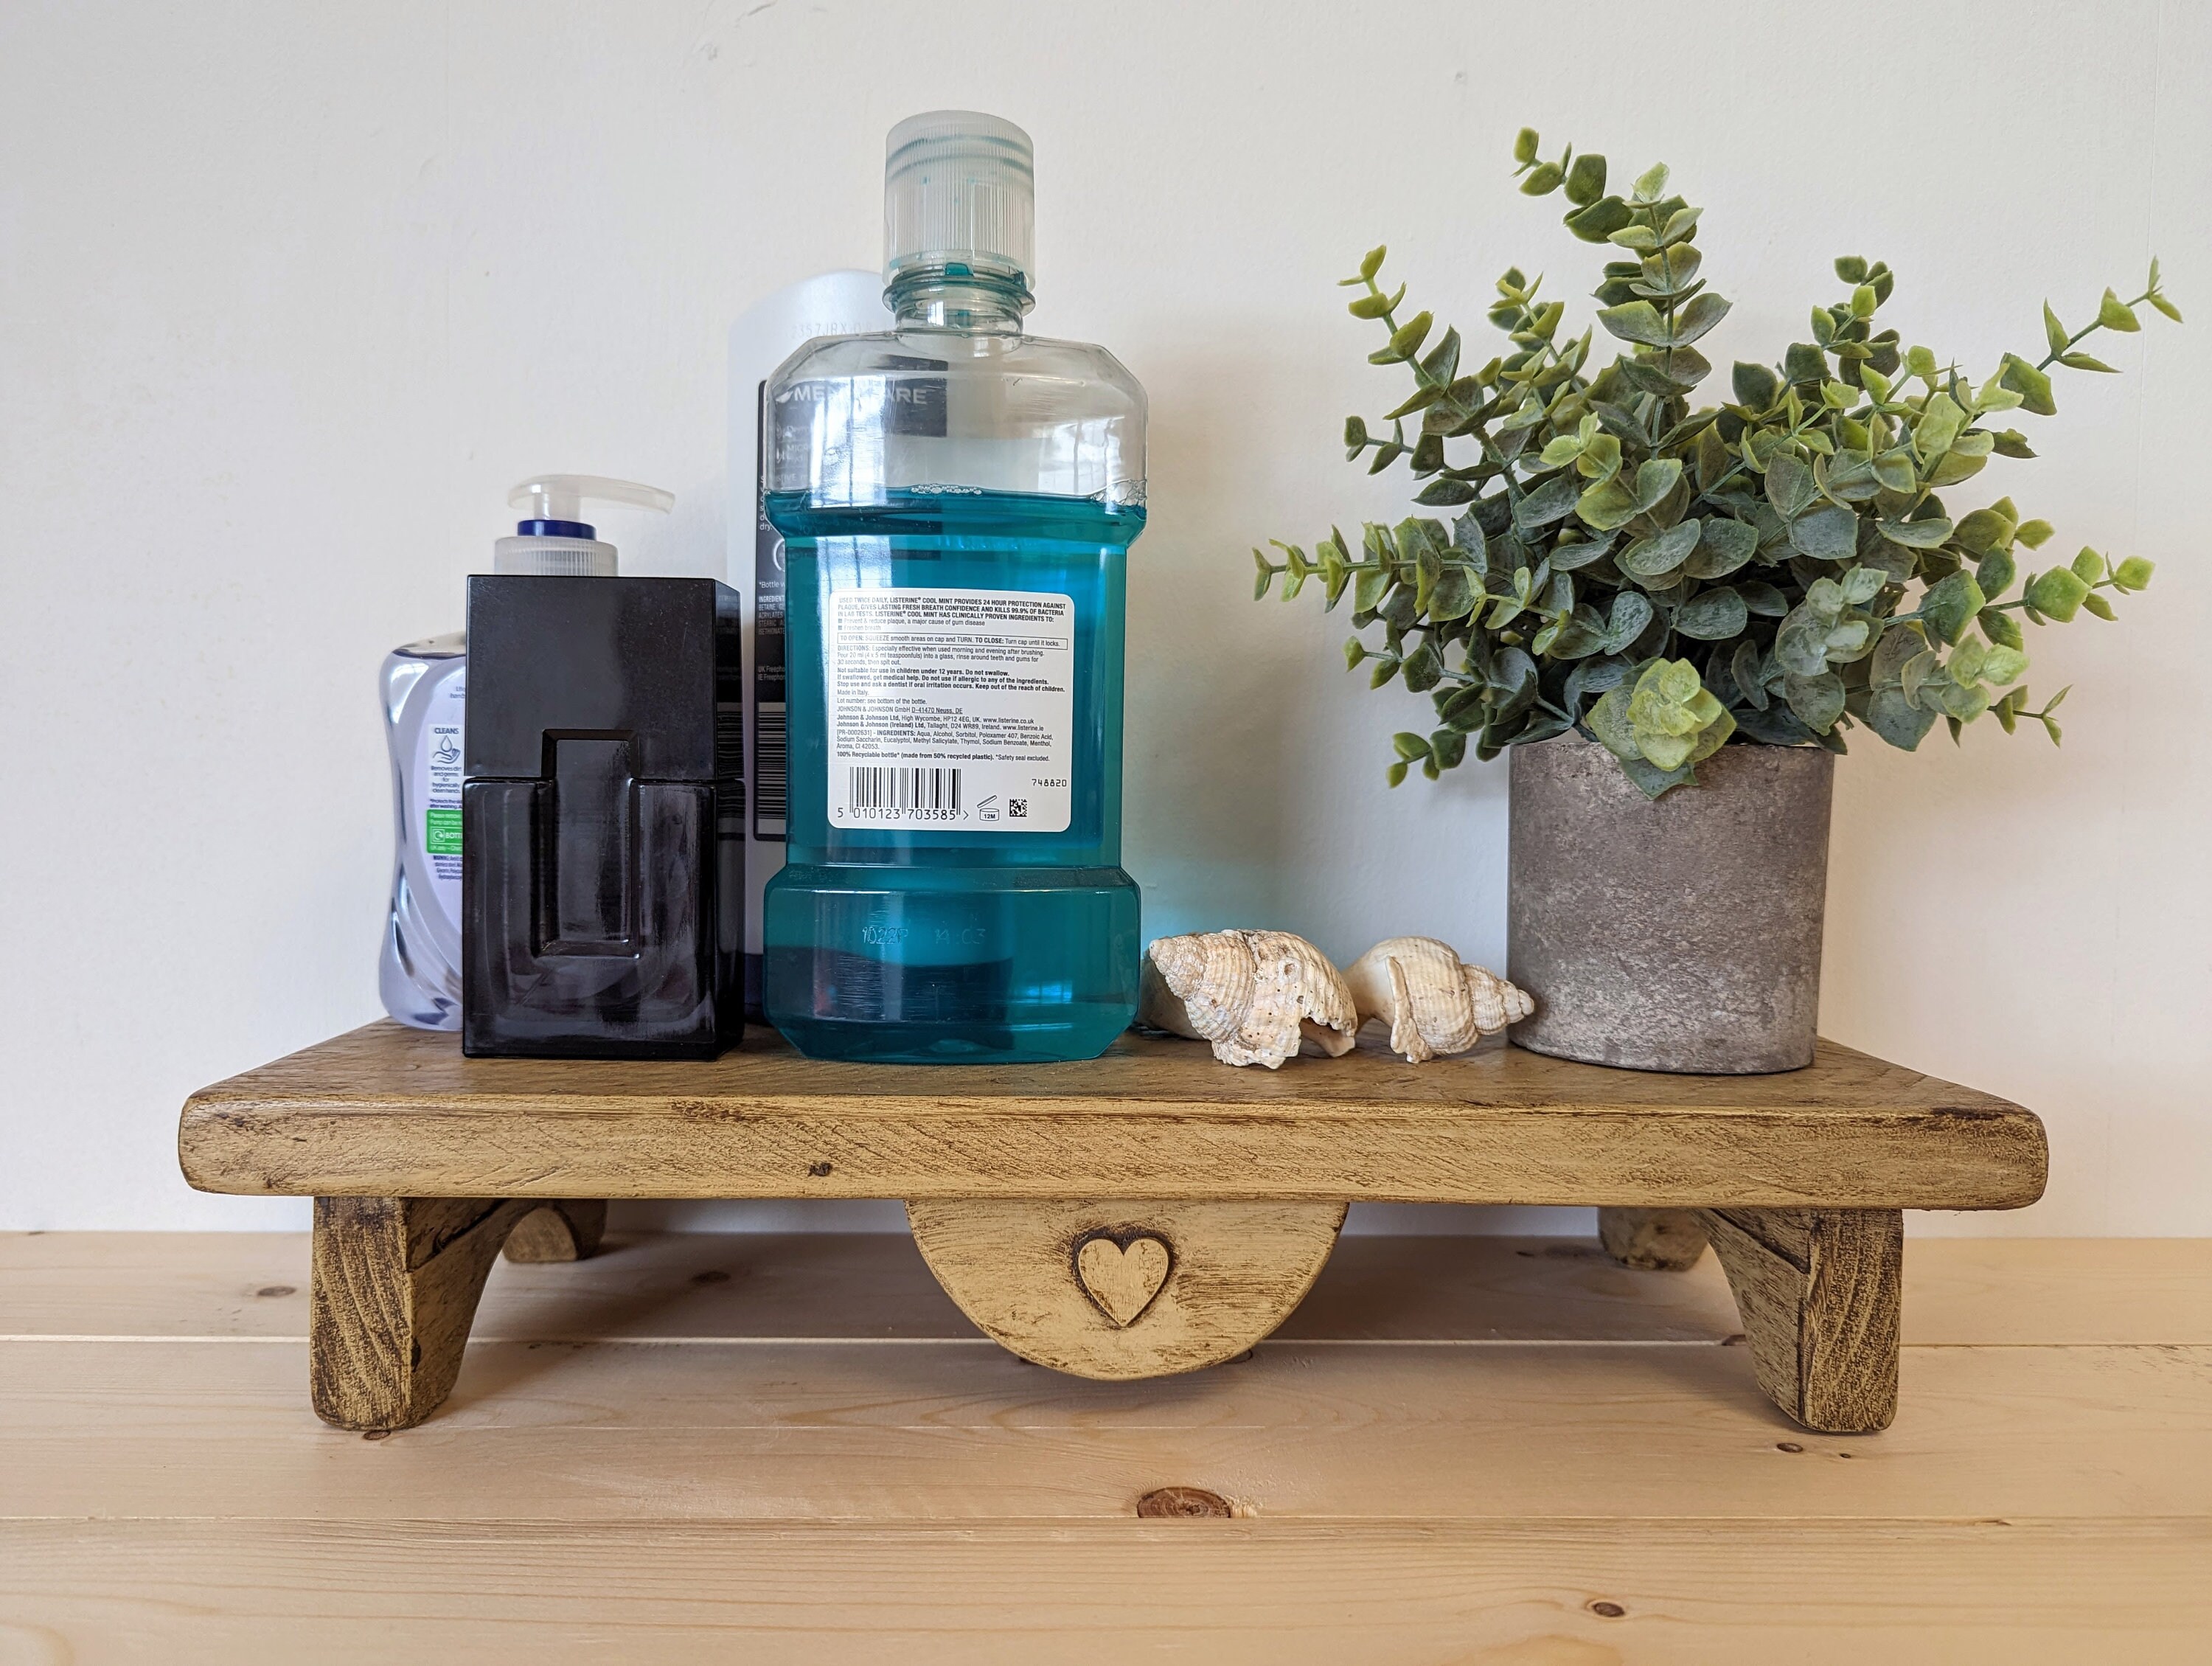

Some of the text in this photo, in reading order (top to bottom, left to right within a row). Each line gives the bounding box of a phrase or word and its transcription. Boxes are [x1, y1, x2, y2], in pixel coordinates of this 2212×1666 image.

[1032, 779, 1067, 787] 748820
[838, 808, 956, 820] 5 010123 703585
